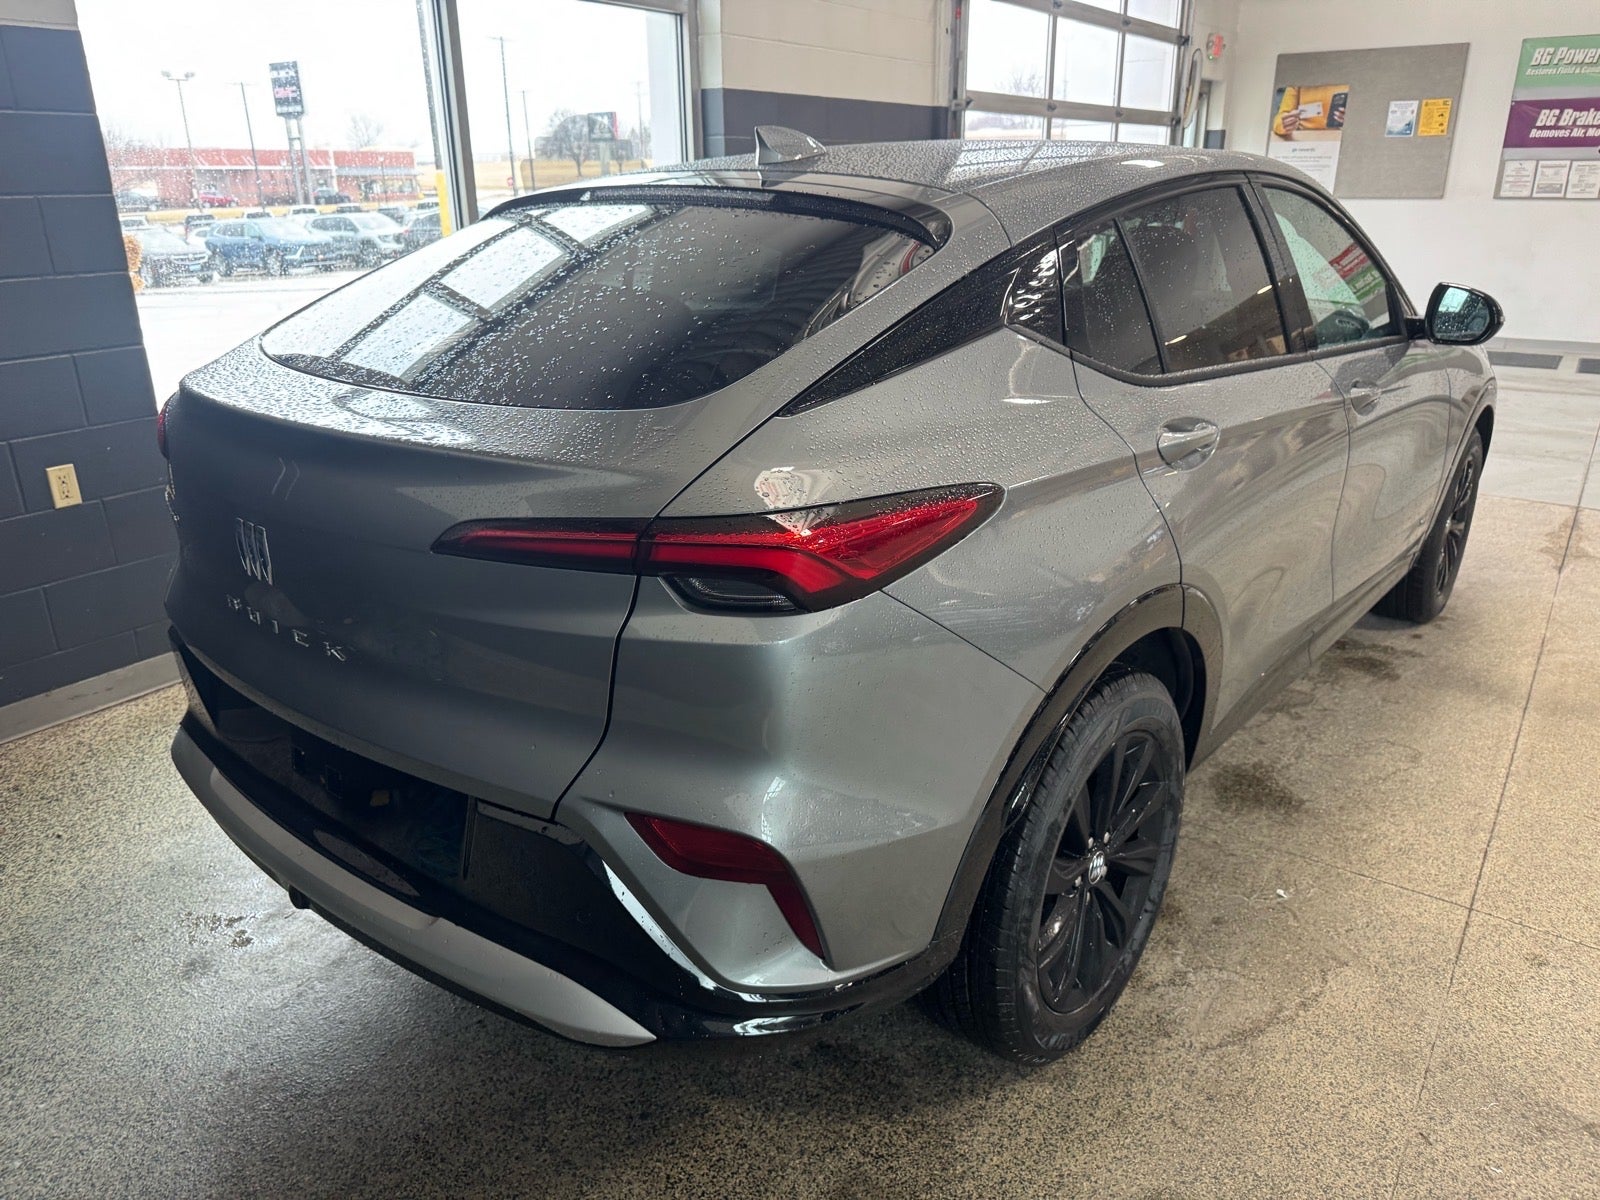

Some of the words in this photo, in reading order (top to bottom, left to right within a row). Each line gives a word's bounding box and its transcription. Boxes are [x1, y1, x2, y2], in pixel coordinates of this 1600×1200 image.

[1530, 48, 1554, 66] BG
[1554, 47, 1600, 65] Power
[1535, 109, 1560, 126] BG
[1558, 108, 1600, 126] Brake
[1529, 129, 1571, 138] Removes
[226, 594, 346, 661] BUICK
